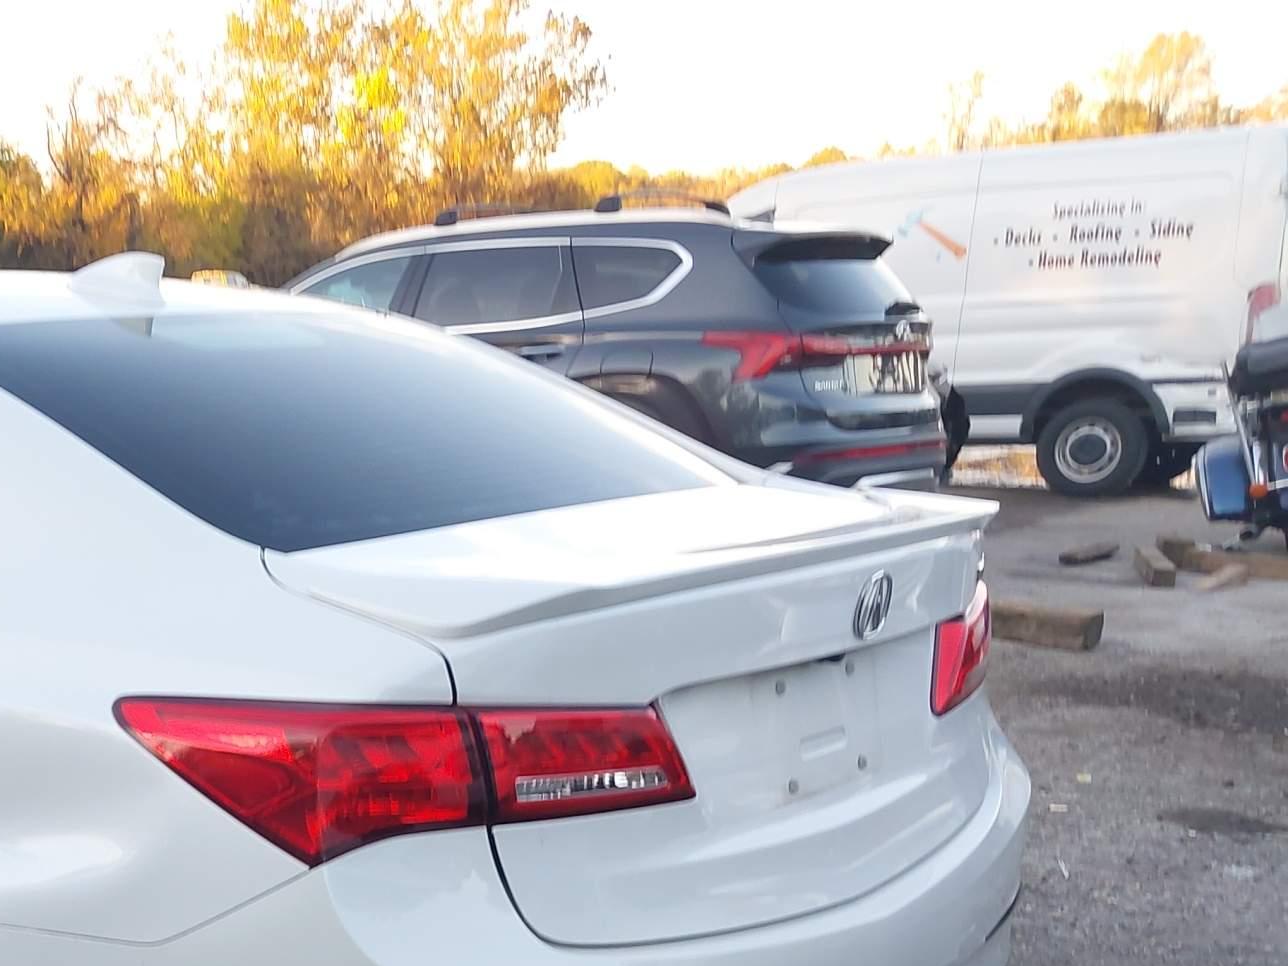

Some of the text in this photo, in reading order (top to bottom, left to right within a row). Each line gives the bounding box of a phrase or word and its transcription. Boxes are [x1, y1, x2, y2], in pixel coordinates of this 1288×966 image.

[1005, 217, 1195, 248] Decks Roofing Siding
[1038, 245, 1162, 270] Home Remodeling
